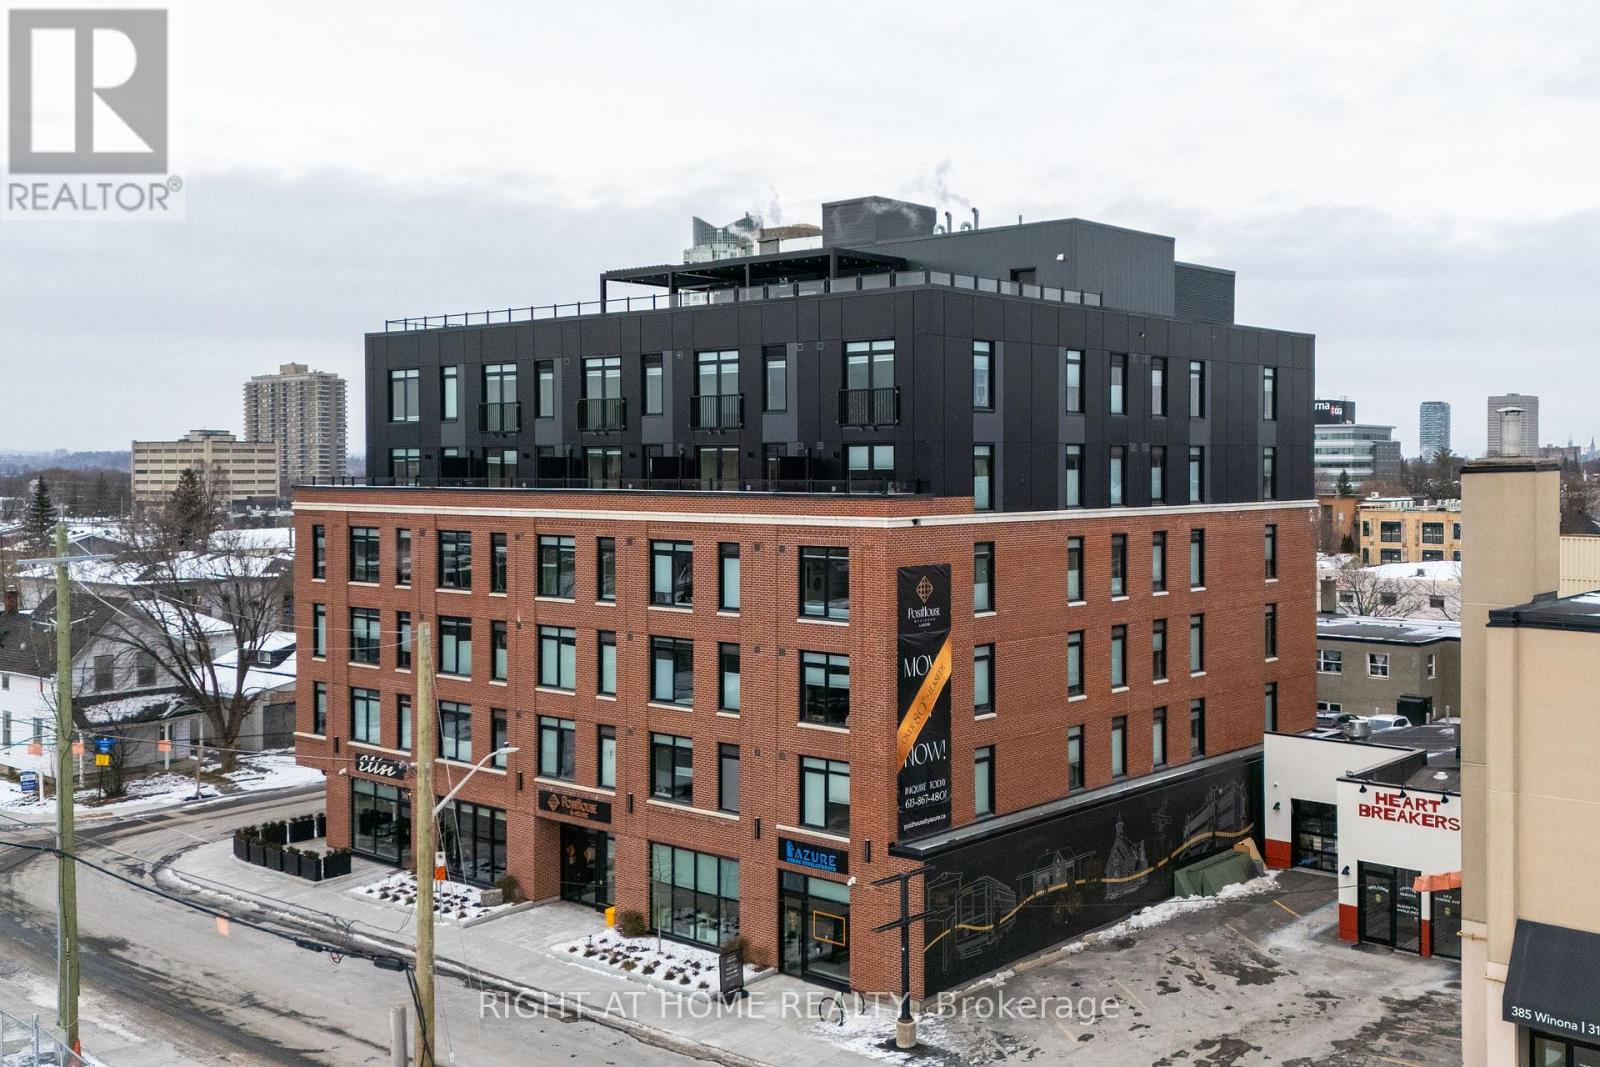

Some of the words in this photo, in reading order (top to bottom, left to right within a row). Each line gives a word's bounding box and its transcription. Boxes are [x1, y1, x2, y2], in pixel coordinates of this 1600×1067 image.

[1375, 791, 1441, 814] HEART
[1358, 803, 1461, 831] BREAKERS
[794, 847, 837, 867] AZURE
[1511, 1006, 1532, 1020] 385
[1534, 1011, 1578, 1031] Winona
